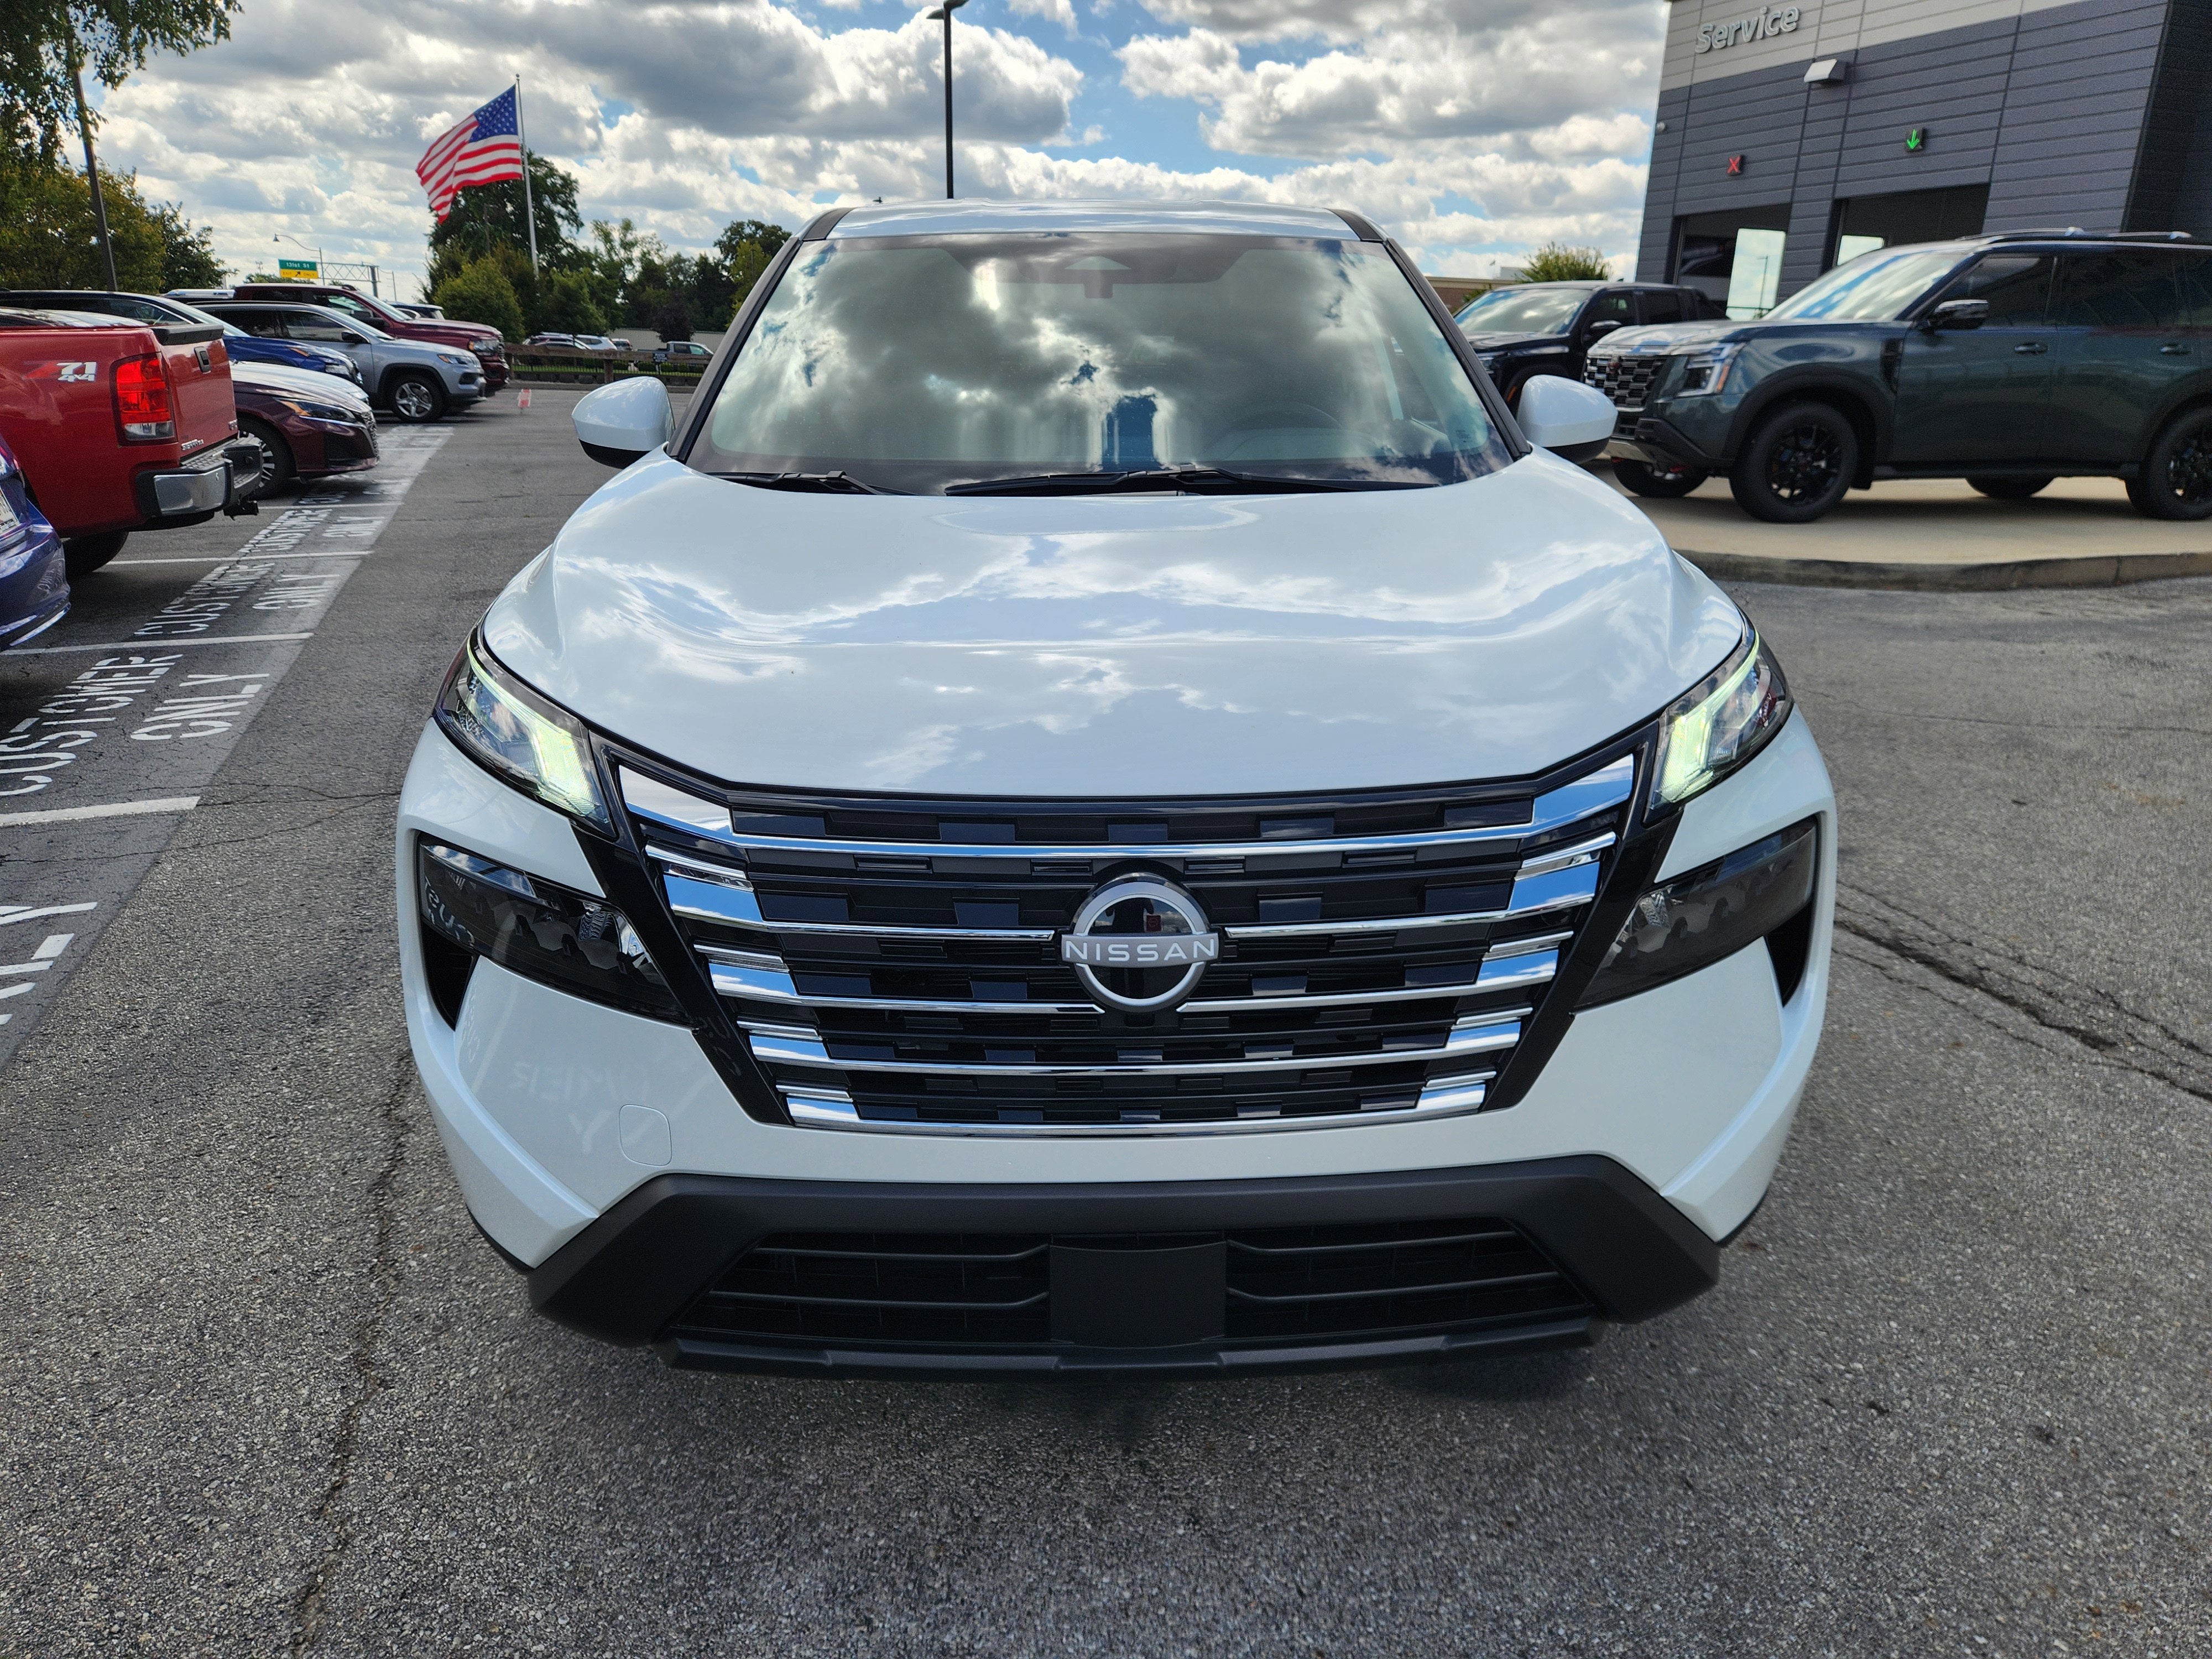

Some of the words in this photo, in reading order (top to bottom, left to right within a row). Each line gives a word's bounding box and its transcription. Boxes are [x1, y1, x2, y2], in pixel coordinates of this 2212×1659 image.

[1694, 6, 1799, 53] Service
[252, 573, 341, 609] ONLY
[131, 673, 270, 740] ONLY
[1065, 938, 1215, 962] NISSAN
